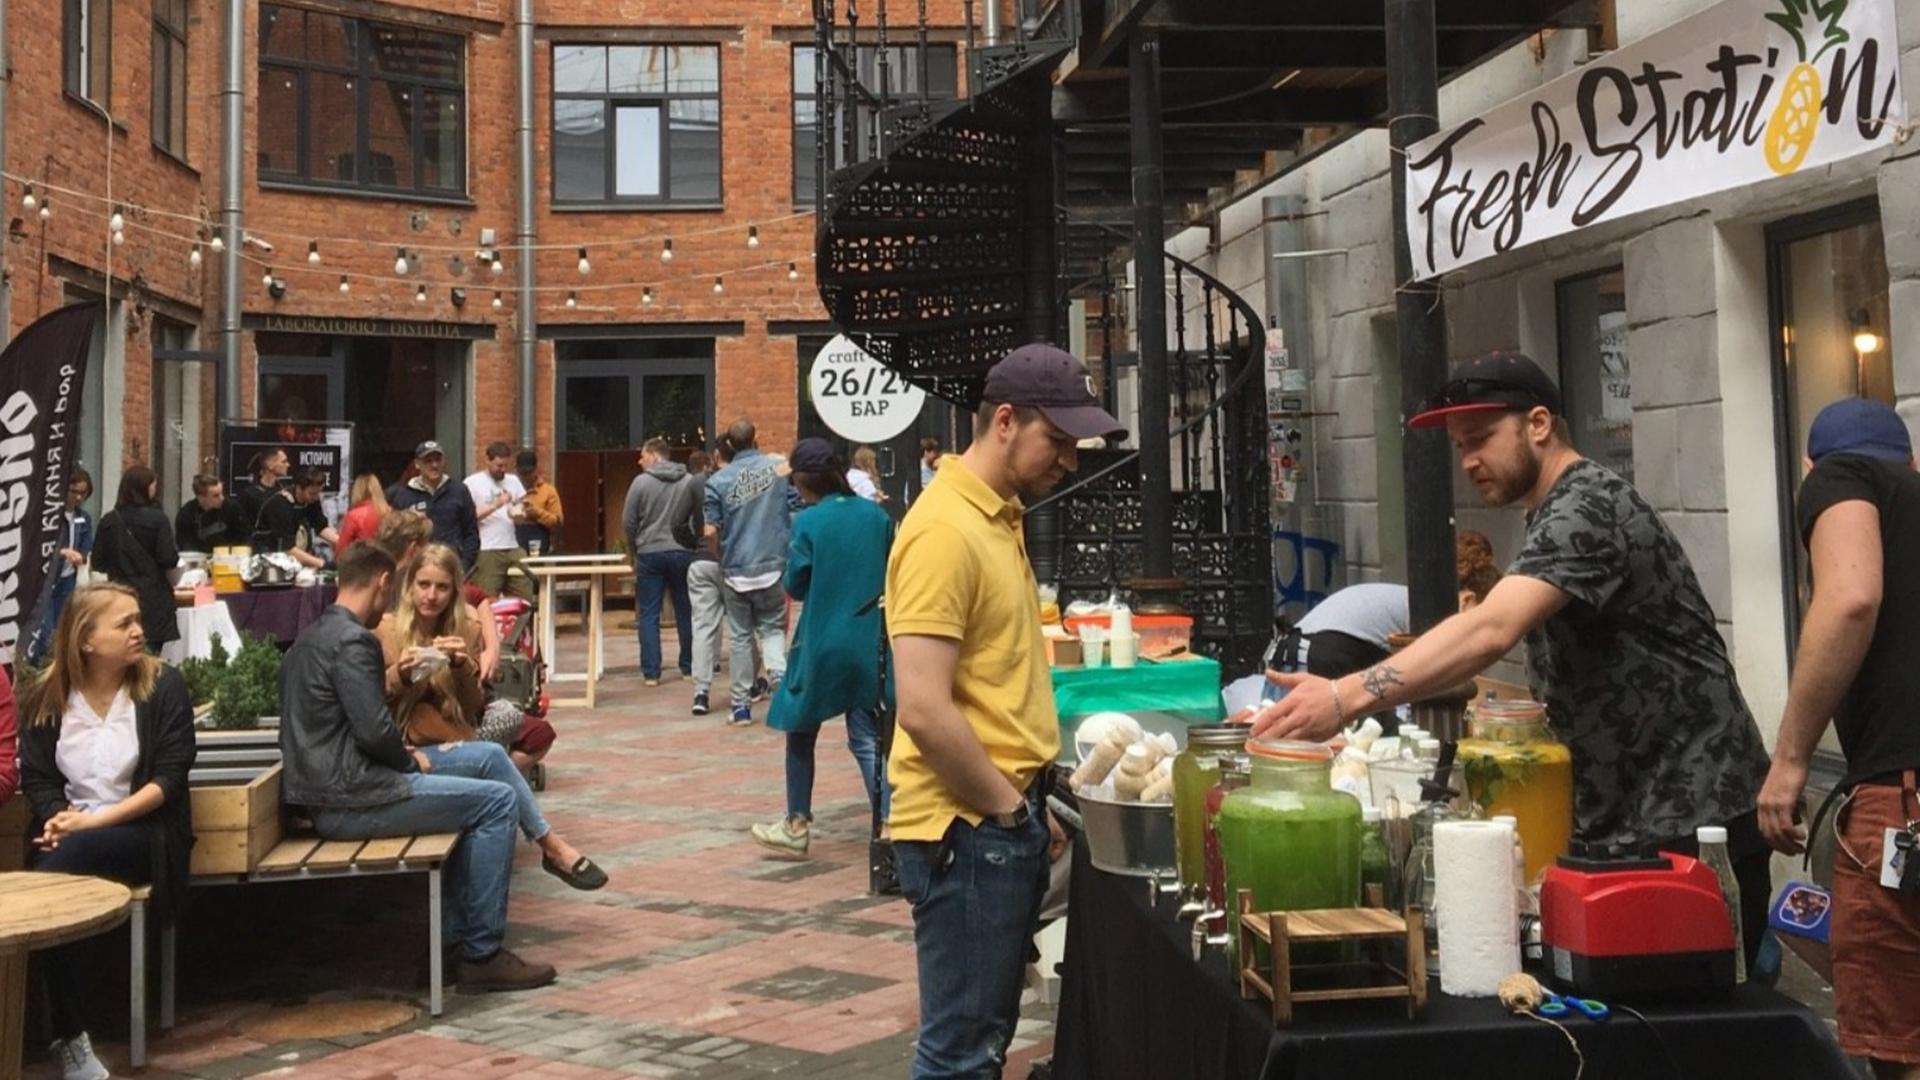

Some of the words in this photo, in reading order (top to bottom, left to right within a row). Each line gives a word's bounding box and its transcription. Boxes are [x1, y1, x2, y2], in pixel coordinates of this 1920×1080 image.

[1409, 101, 1581, 272] Fresh
[828, 350, 866, 363] craft
[851, 400, 889, 417] БАР
[299, 451, 334, 465] ИСТОРИЯ
